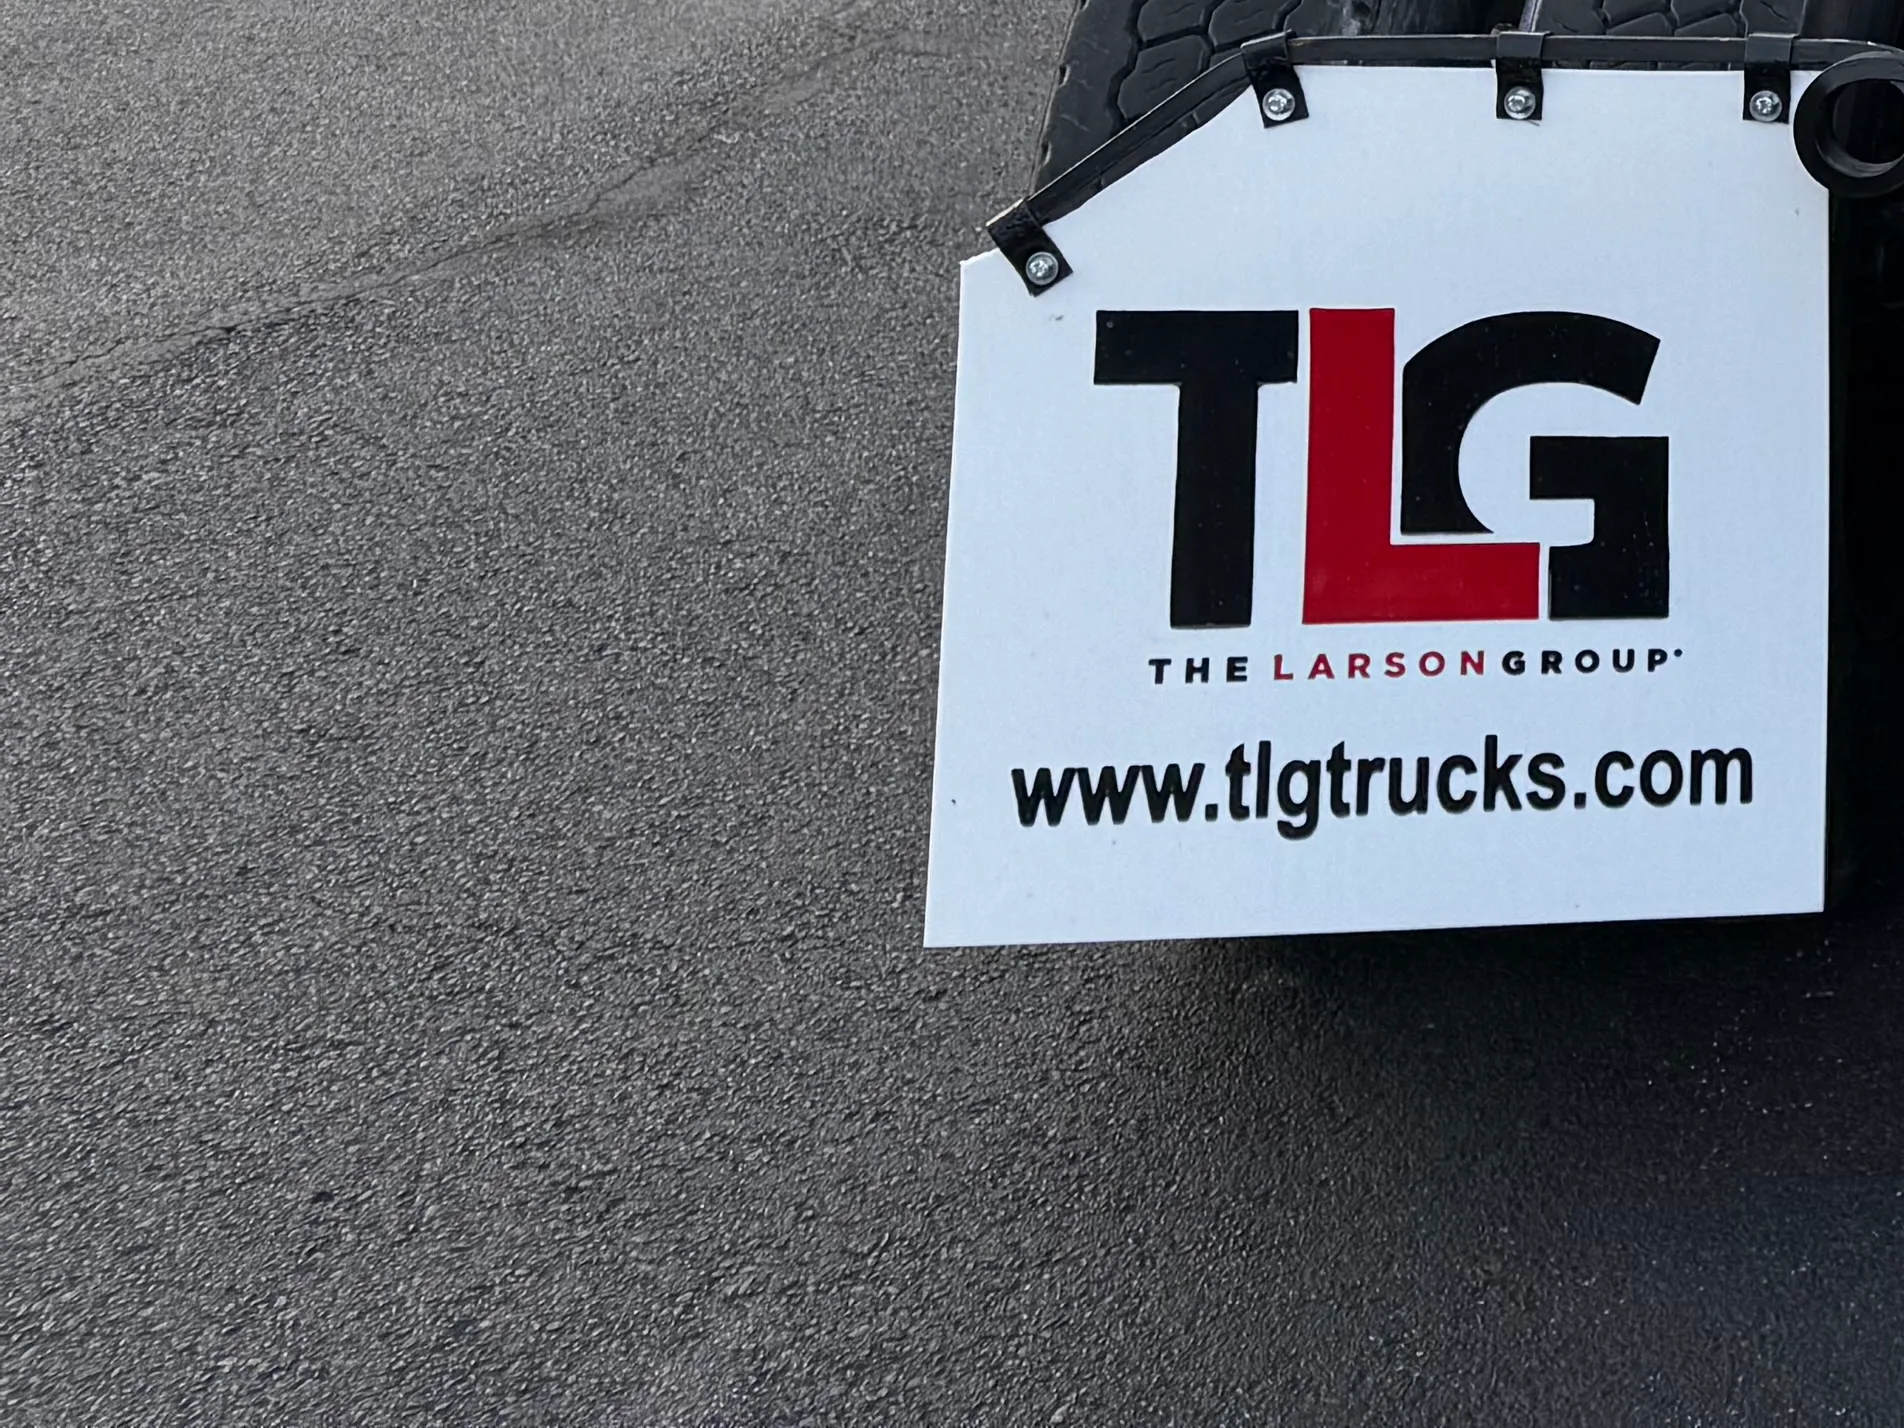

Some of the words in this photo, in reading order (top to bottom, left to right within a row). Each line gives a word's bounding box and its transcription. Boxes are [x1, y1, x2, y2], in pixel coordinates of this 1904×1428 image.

[1093, 307, 1670, 629] TLG
[1148, 654, 1250, 685] THE
[1273, 650, 1486, 682] LARSON
[1010, 734, 1755, 841] www.tlgtrucks.com
